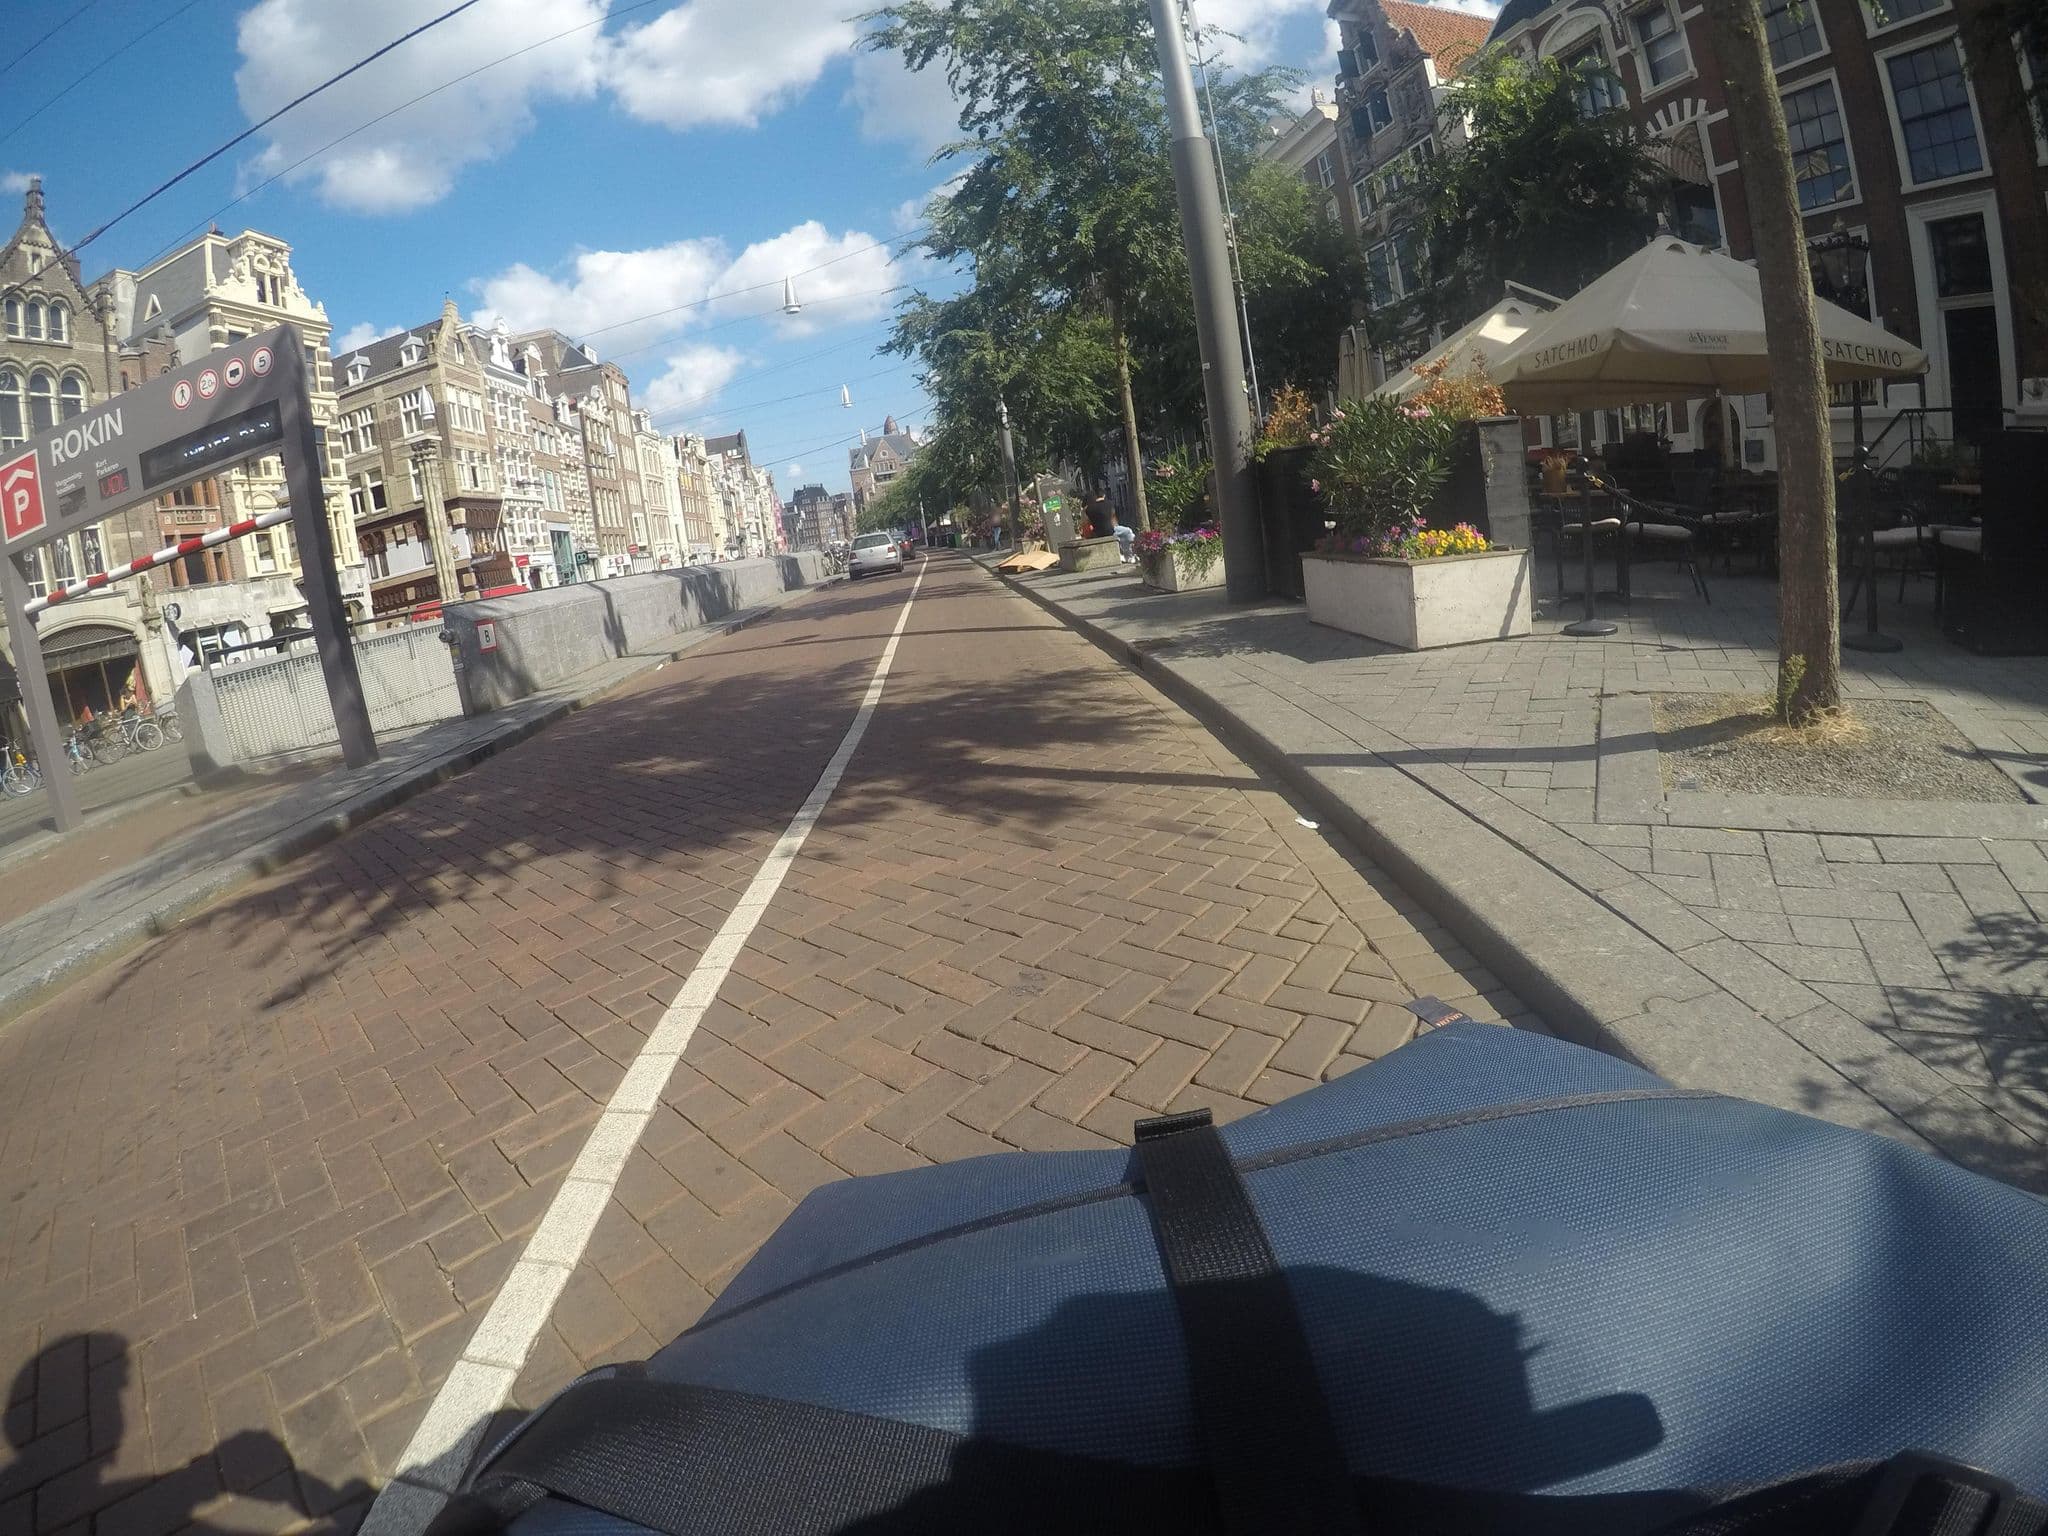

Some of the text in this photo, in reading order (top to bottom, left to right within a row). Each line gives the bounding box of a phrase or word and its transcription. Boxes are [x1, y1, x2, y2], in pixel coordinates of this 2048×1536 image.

[258, 356, 266, 368] 5
[1534, 333, 1598, 369] SATCHMO
[1823, 340, 1902, 367] SATCHMO
[50, 407, 124, 467] ROKIN
[13, 488, 30, 526] P
